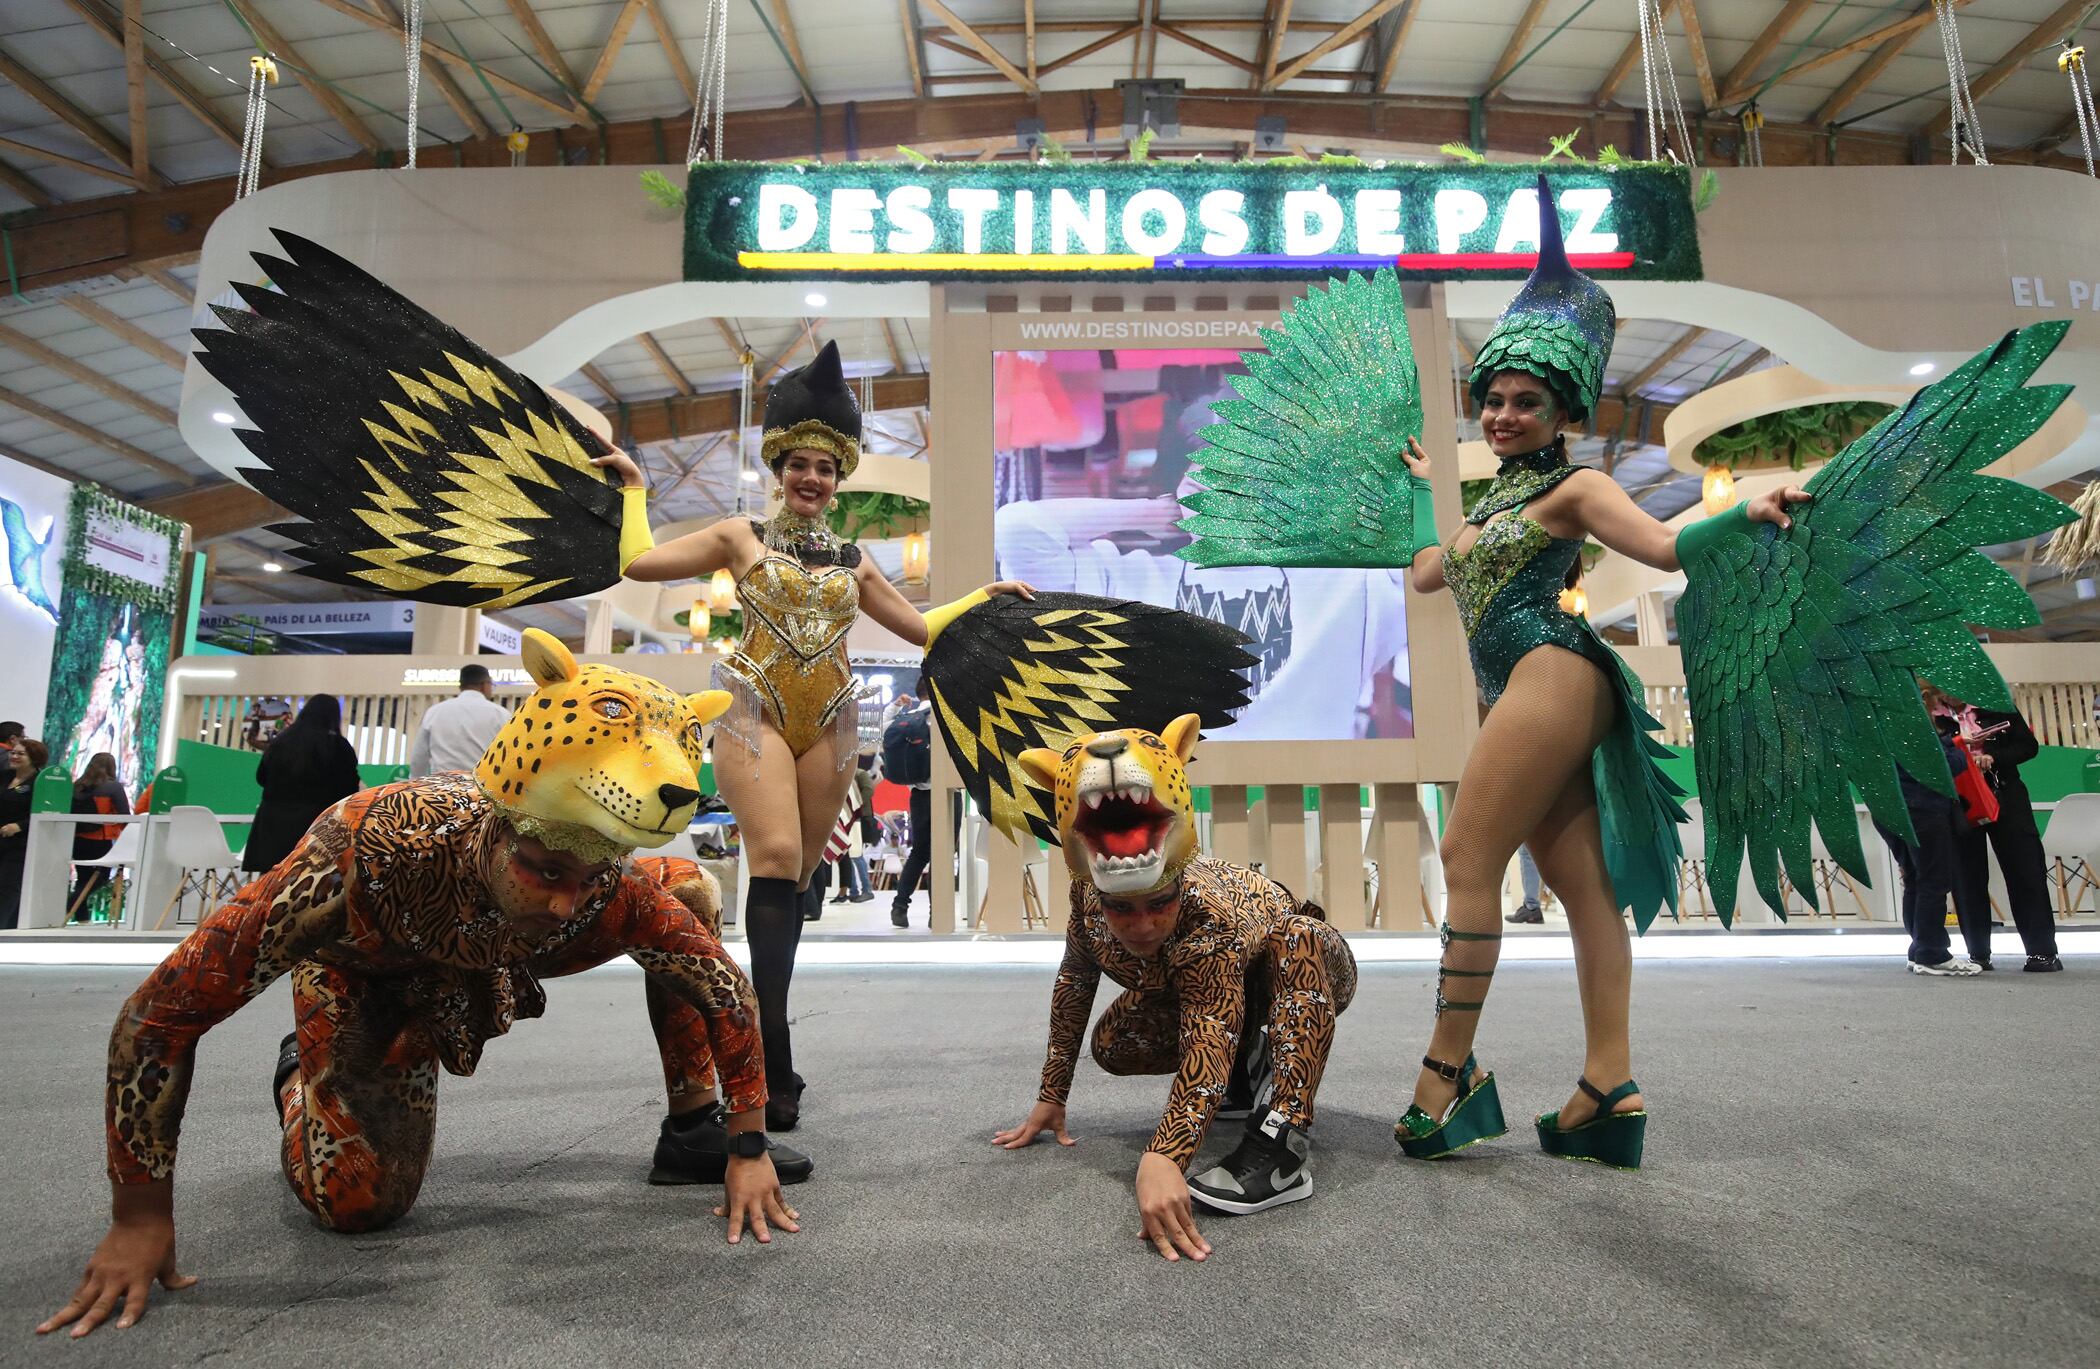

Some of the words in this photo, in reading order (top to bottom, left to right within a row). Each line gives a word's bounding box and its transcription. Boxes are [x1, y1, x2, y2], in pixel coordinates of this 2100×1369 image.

[758, 184, 1250, 257] DESTINOS
[1284, 188, 1404, 256] DE
[1434, 188, 1619, 253] PAZ
[2010, 276, 2056, 307] EL
[264, 612, 287, 624] PAÍS
[291, 614, 304, 624] DE
[309, 614, 321, 623] LA
[325, 613, 370, 623] BELLEZA
[403, 609, 414, 623] 3
